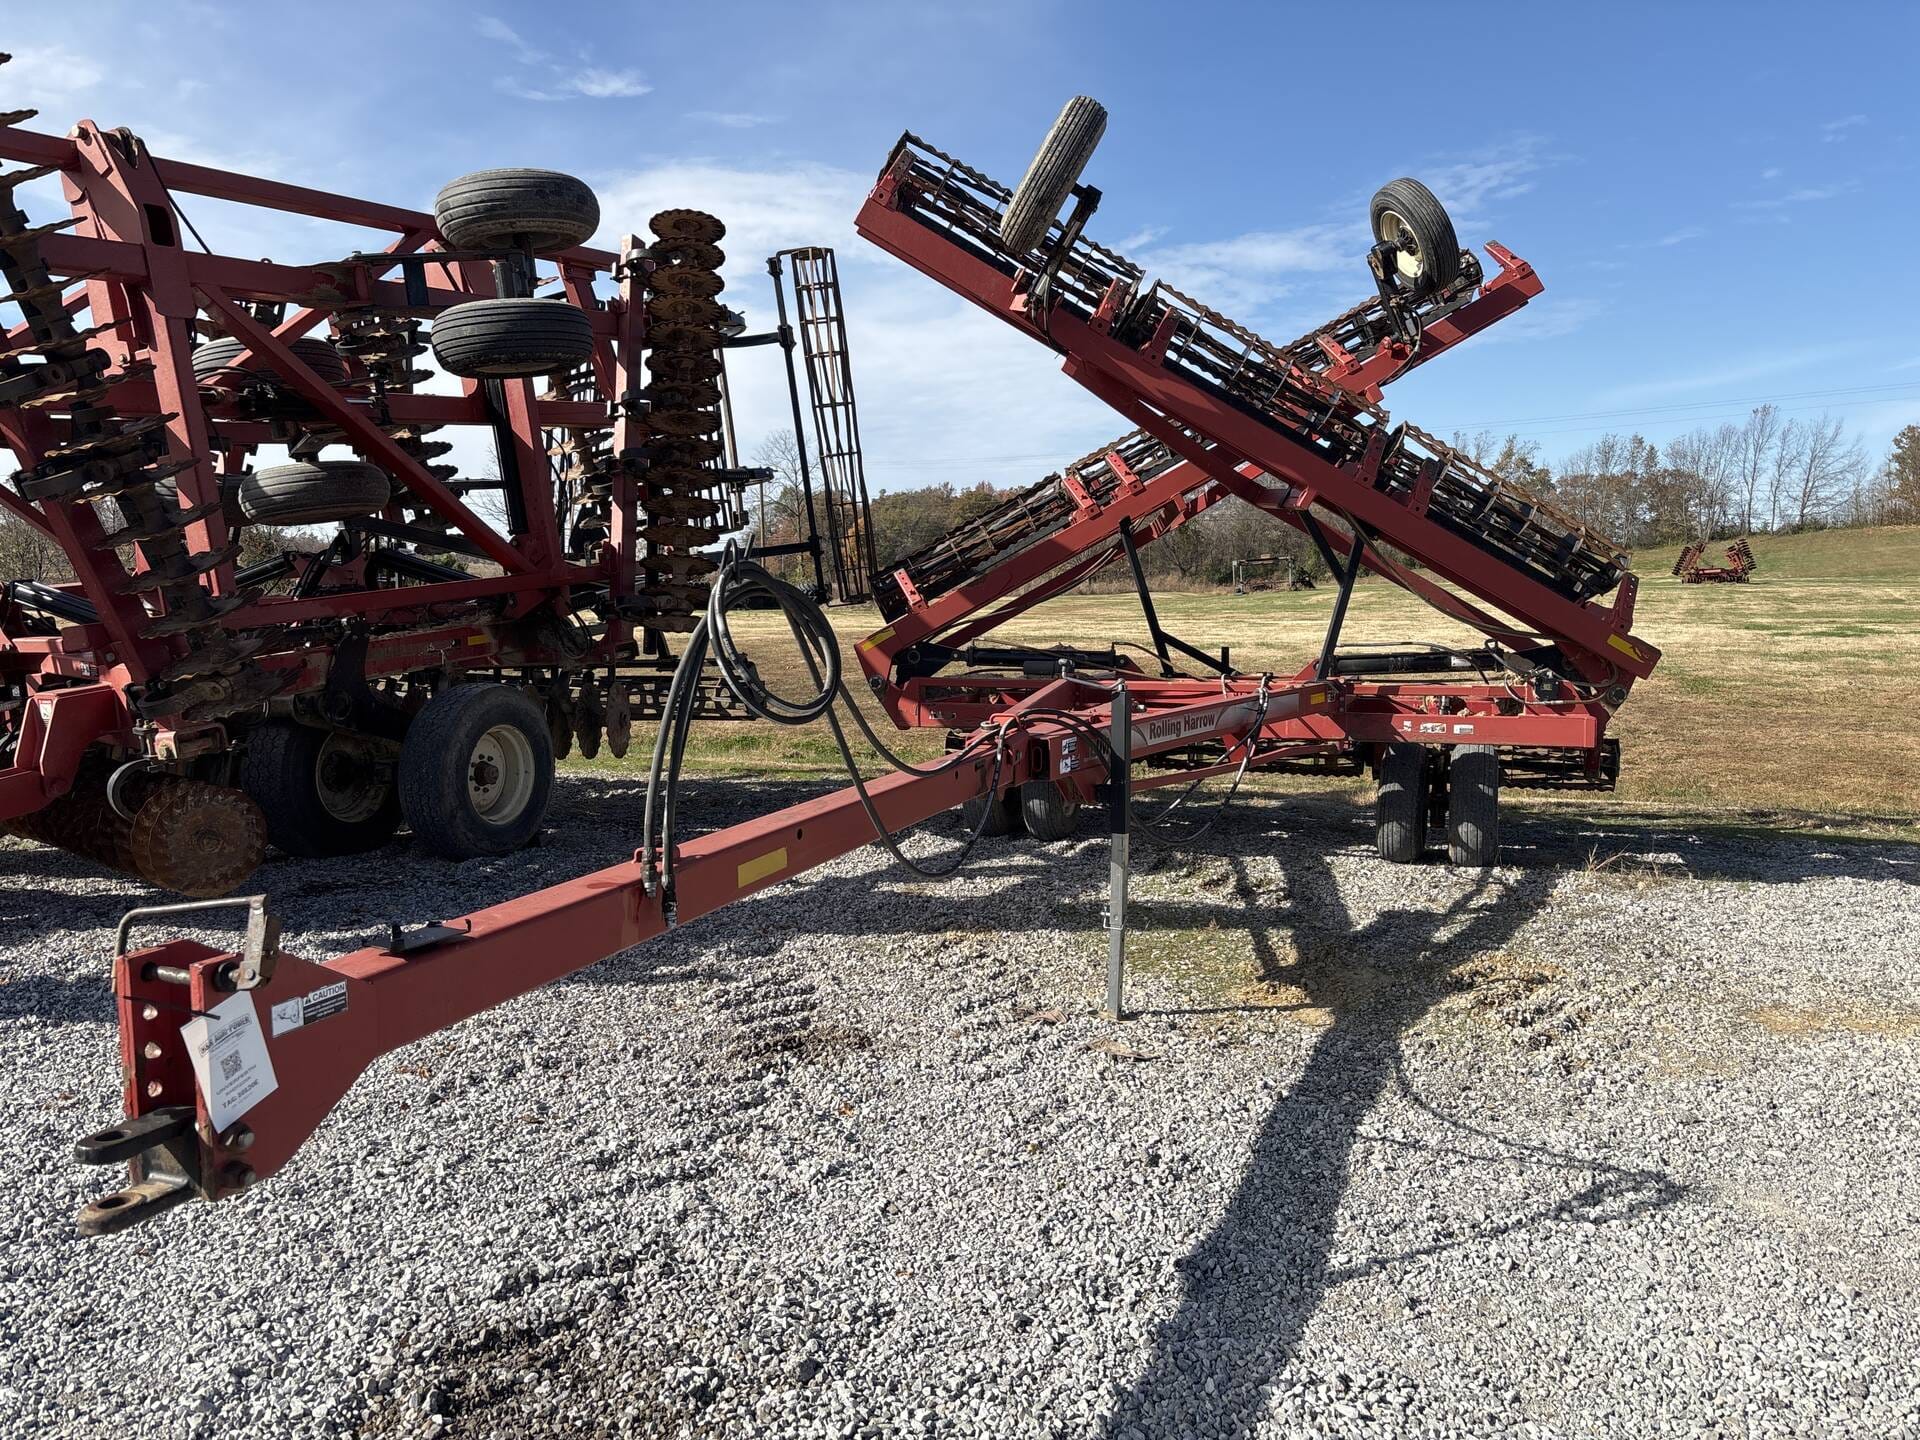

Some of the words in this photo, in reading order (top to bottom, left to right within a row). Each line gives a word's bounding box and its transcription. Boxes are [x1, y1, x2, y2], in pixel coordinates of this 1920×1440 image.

[1149, 719, 1181, 739] Rolling
[1184, 713, 1215, 732] Harrow
[312, 983, 345, 1001] CAUTION
